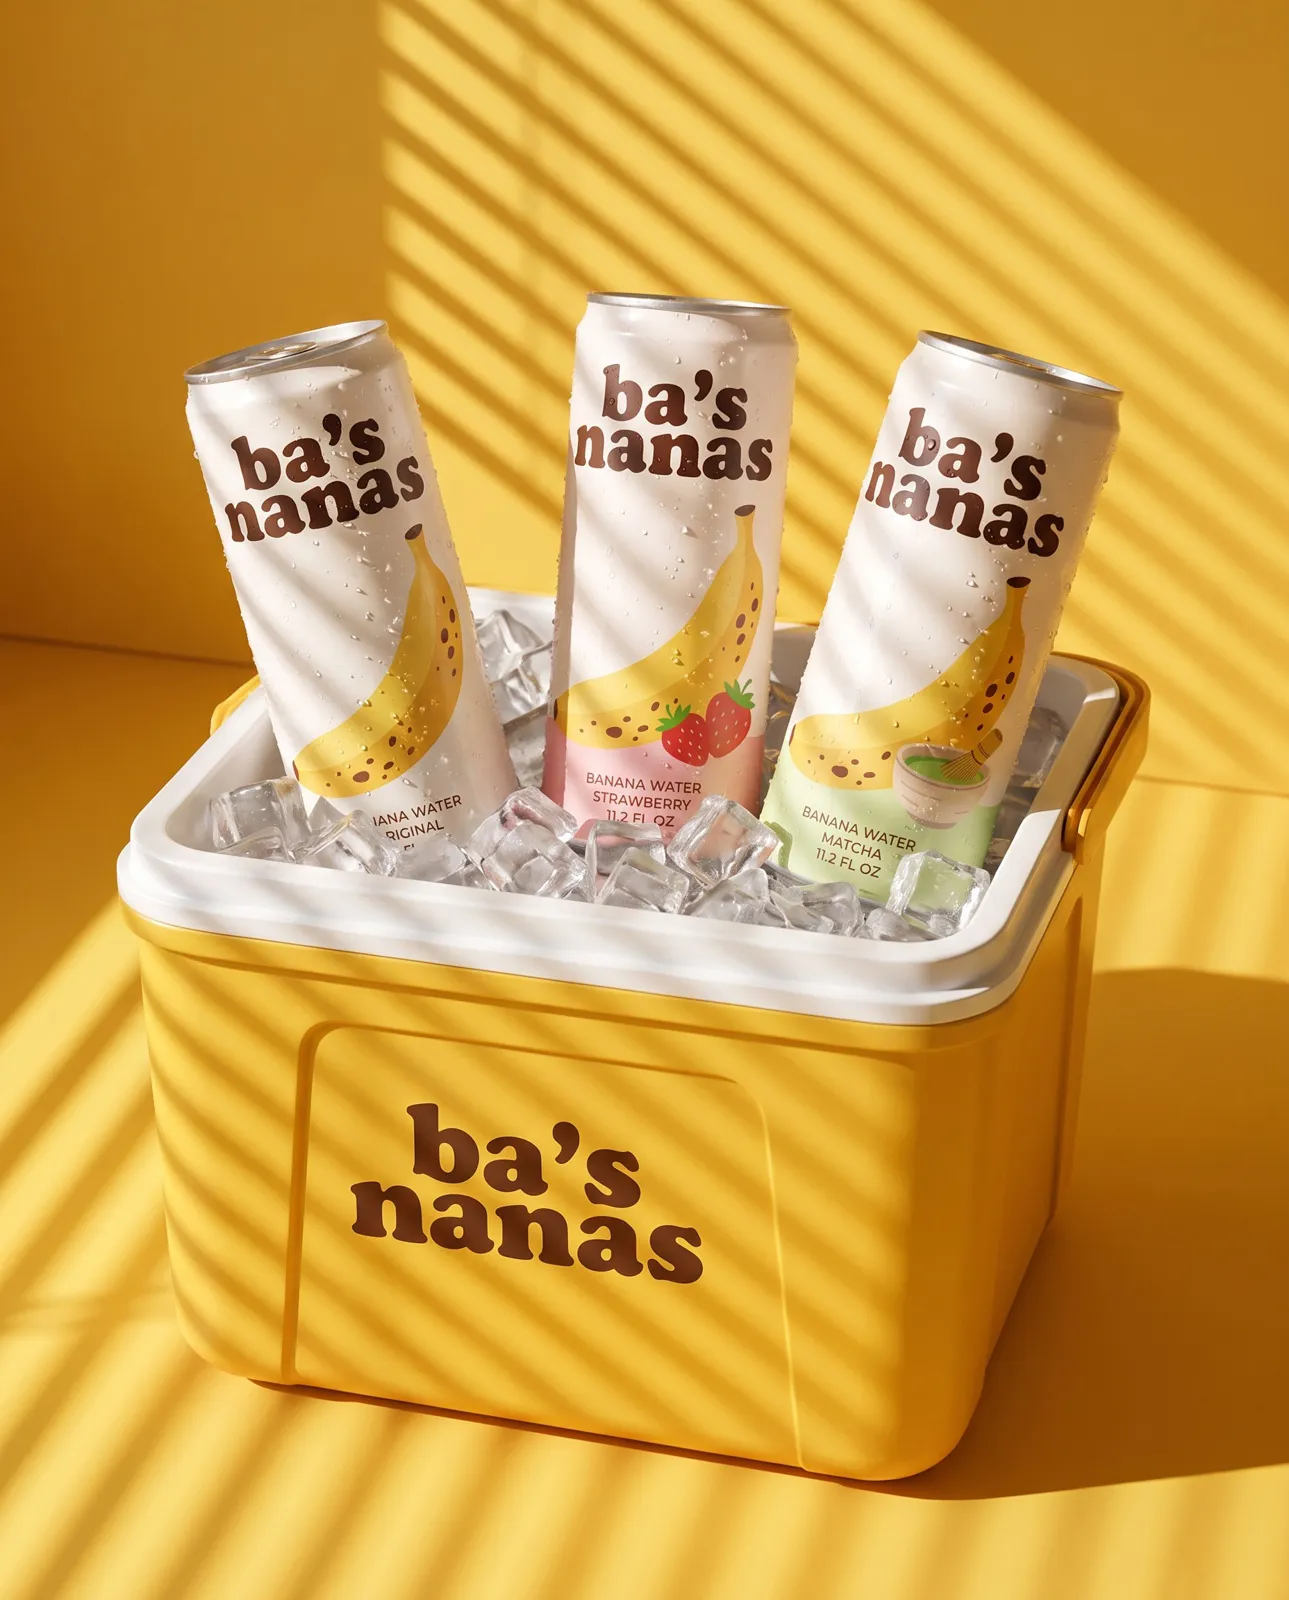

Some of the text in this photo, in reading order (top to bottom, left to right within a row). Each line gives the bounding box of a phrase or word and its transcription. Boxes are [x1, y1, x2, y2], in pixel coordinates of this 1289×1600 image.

[604, 363, 747, 431] ba’s
[231, 413, 386, 491] ba’s
[574, 422, 773, 481] nanas
[898, 407, 1046, 501] ba’s
[224, 455, 425, 543] nanas
[864, 461, 1065, 558] nanas
[411, 794, 462, 818] WATER
[586, 772, 702, 794] BANANA WATER
[592, 790, 692, 811] STRAWBERRY
[385, 819, 445, 841] RIGINAL
[653, 815, 675, 828] OZ
[802, 805, 917, 852] BANANA WATER
[821, 831, 882, 861] MATCHA
[816, 847, 882, 878] 11.2 FL OZ
[406, 1103, 641, 1208] ba’s
[350, 1181, 703, 1284] nanas
